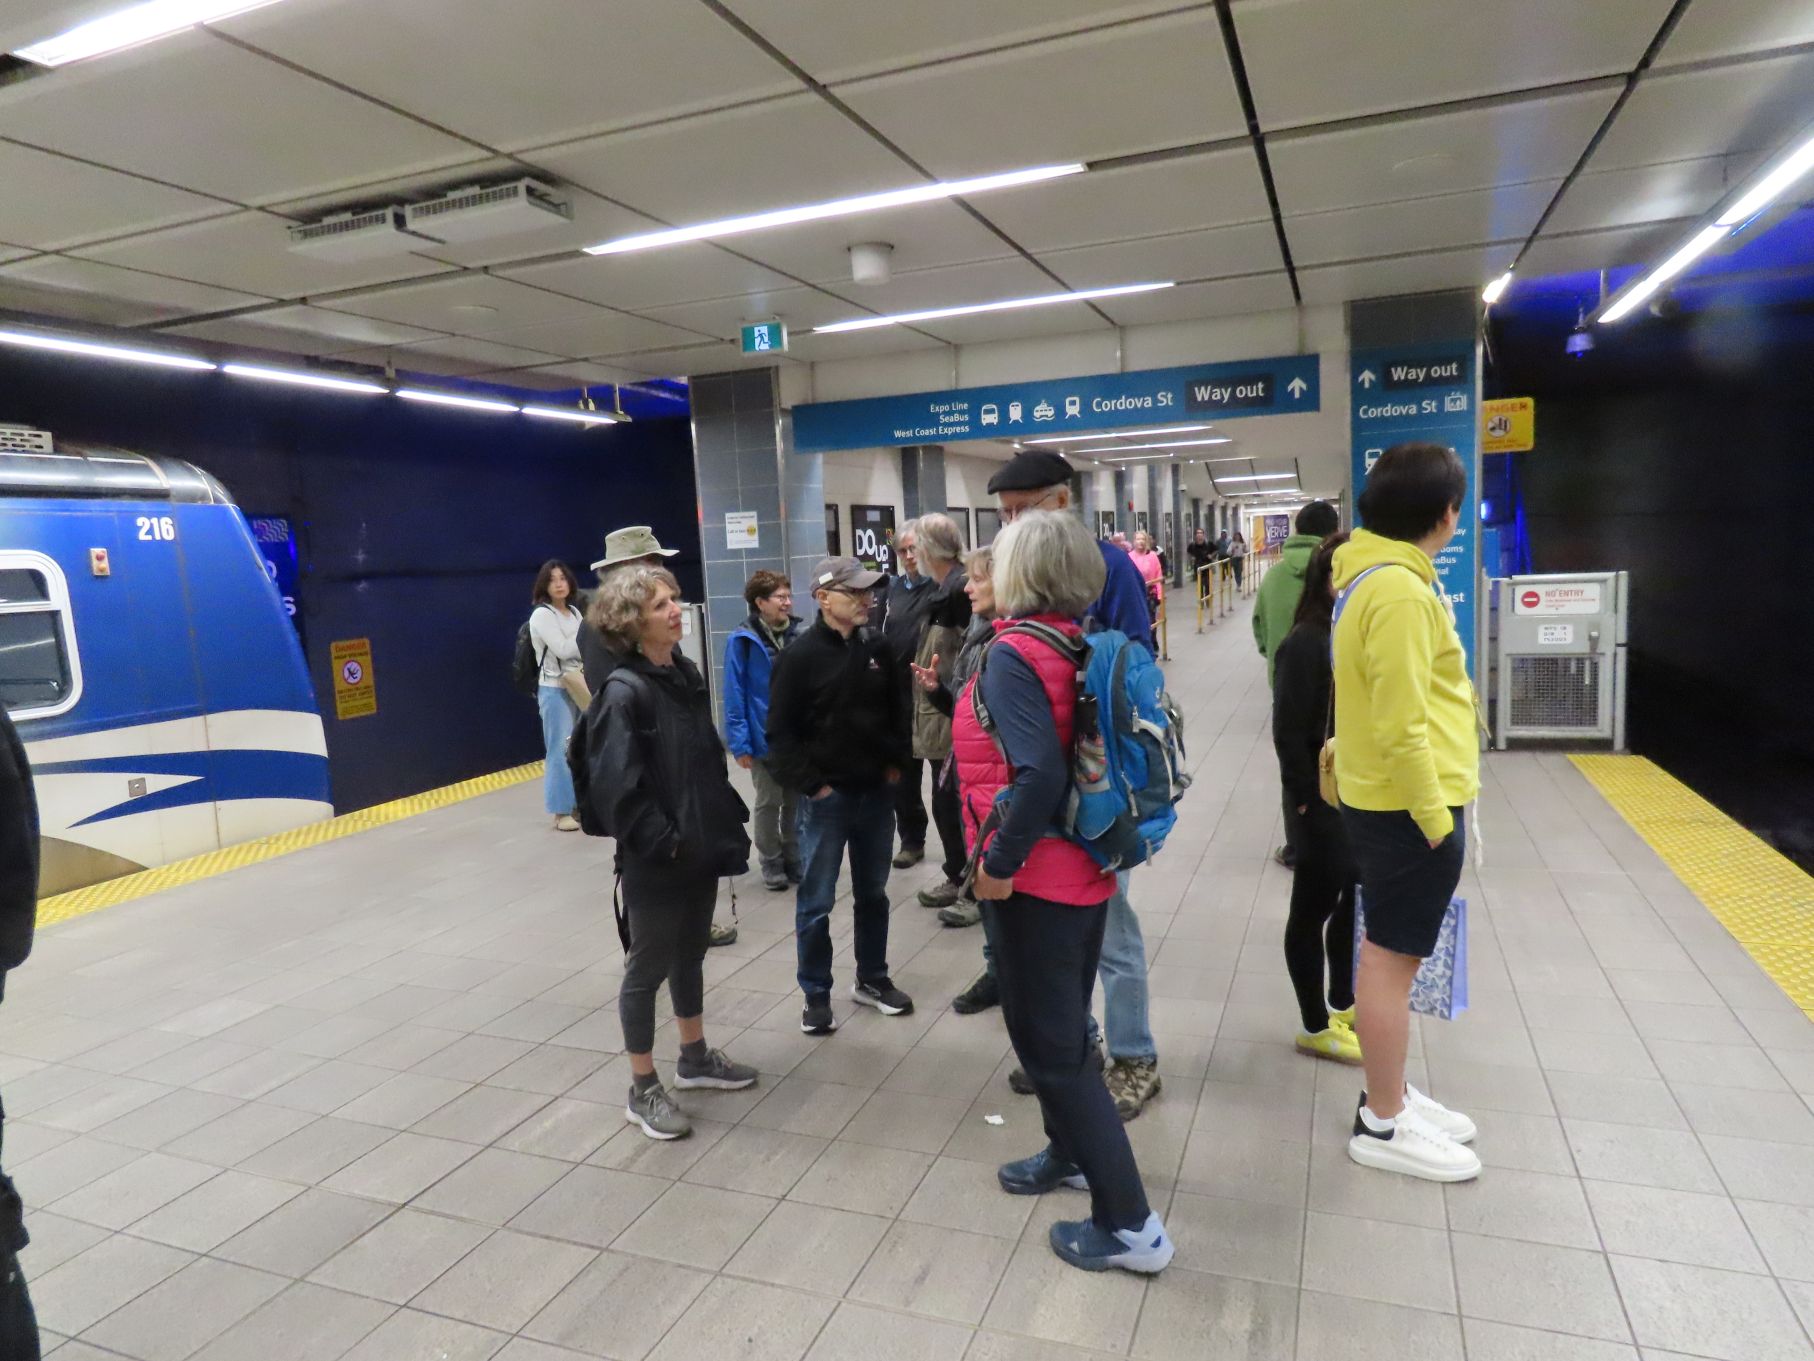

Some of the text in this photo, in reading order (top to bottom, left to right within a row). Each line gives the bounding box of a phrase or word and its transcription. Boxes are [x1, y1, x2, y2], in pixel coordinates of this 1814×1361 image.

[1391, 362, 1458, 382] Way out
[1194, 381, 1265, 404] Way out
[930, 402, 969, 414] Expo Line
[1092, 392, 1173, 412] Cordova St
[1359, 400, 1437, 418] Cordova St
[939, 413, 969, 424] SeaBus
[893, 425, 970, 438] West Coast Express
[136, 516, 175, 541] 216
[1545, 589, 1585, 598] NO ENTRY
